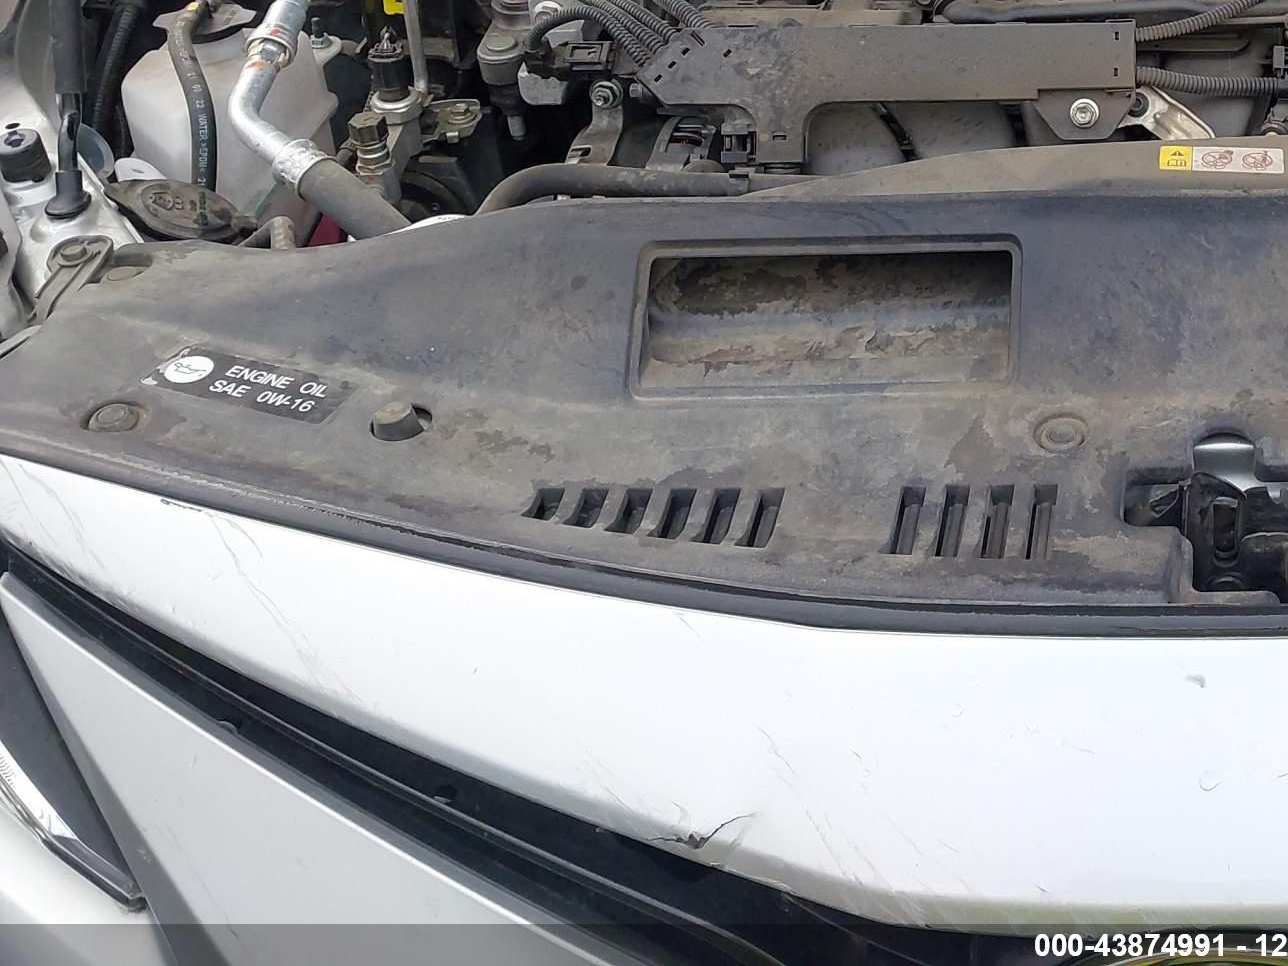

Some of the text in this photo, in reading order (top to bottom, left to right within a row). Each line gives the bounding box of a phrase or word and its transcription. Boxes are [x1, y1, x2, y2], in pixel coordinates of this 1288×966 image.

[198, 114, 208, 140] WATER
[209, 379, 316, 412] SAE 0W-16
[225, 365, 328, 398] ENGINE OIL
